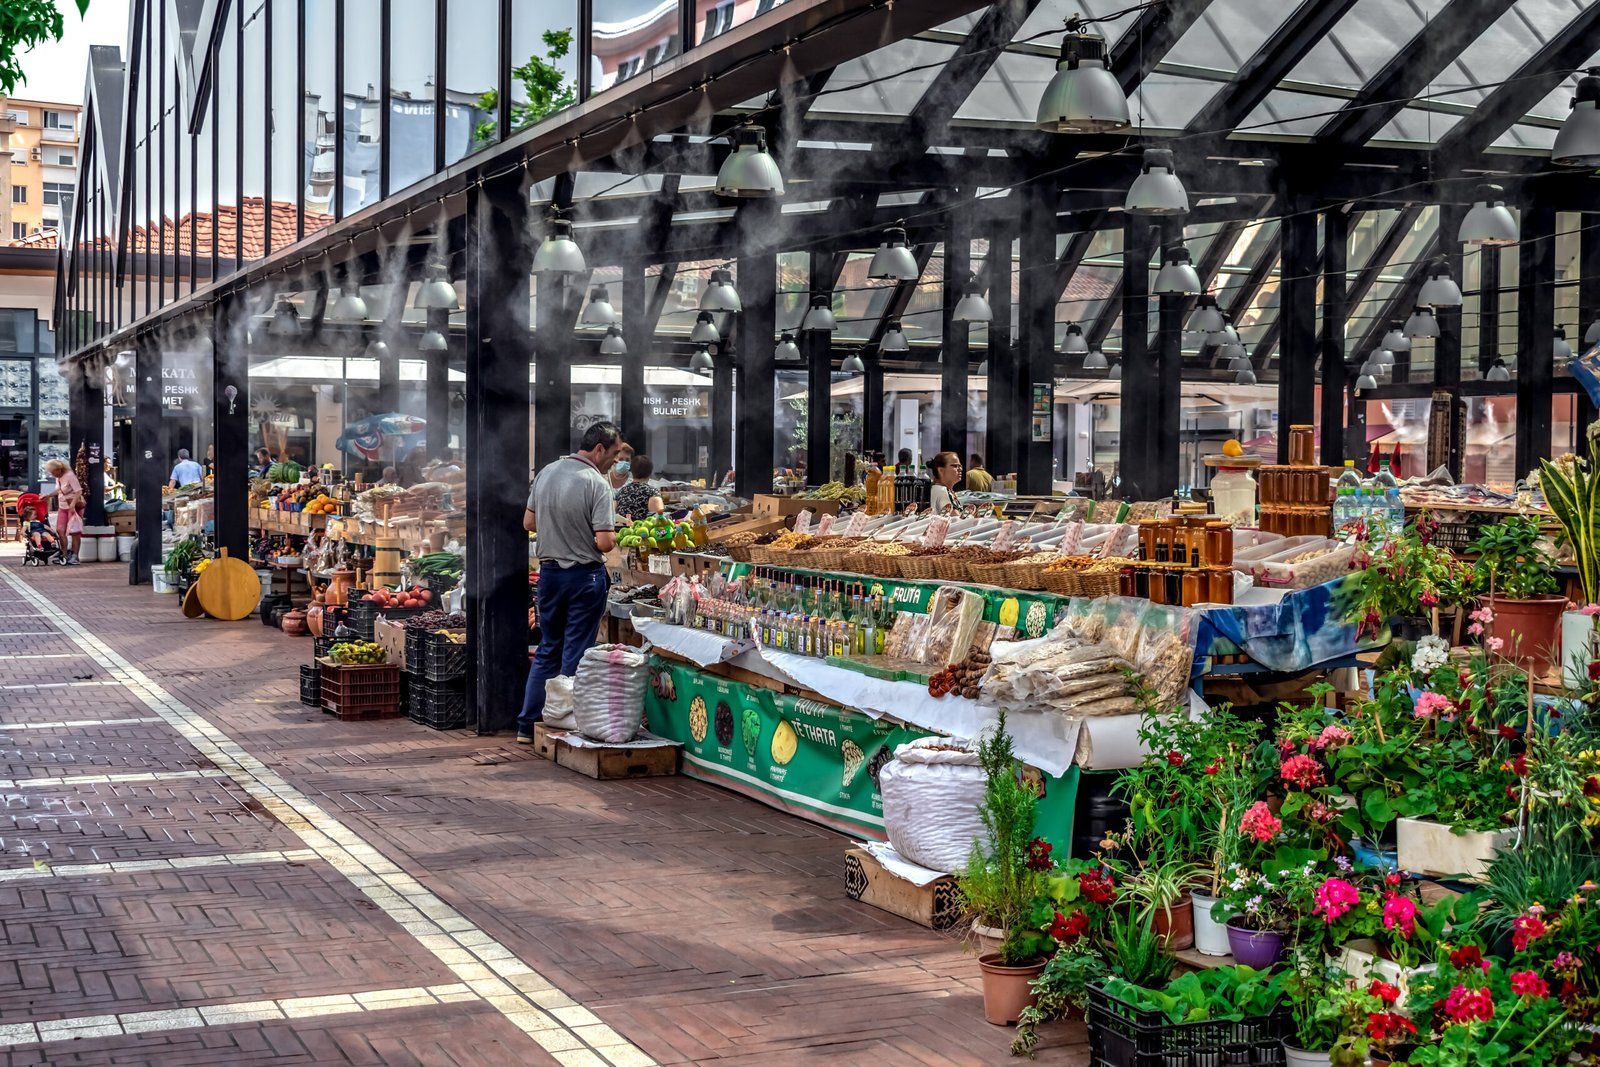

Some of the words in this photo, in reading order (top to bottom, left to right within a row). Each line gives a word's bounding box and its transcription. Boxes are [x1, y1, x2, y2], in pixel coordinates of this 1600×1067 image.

[164, 386, 198, 394] PESHK
[672, 398, 701, 406] PESHK
[654, 407, 688, 415] BULMET
[892, 586, 920, 604] FRUTA
[794, 698, 829, 718] FRUTA
[791, 718, 805, 738] TË
[802, 722, 836, 747] THATA
